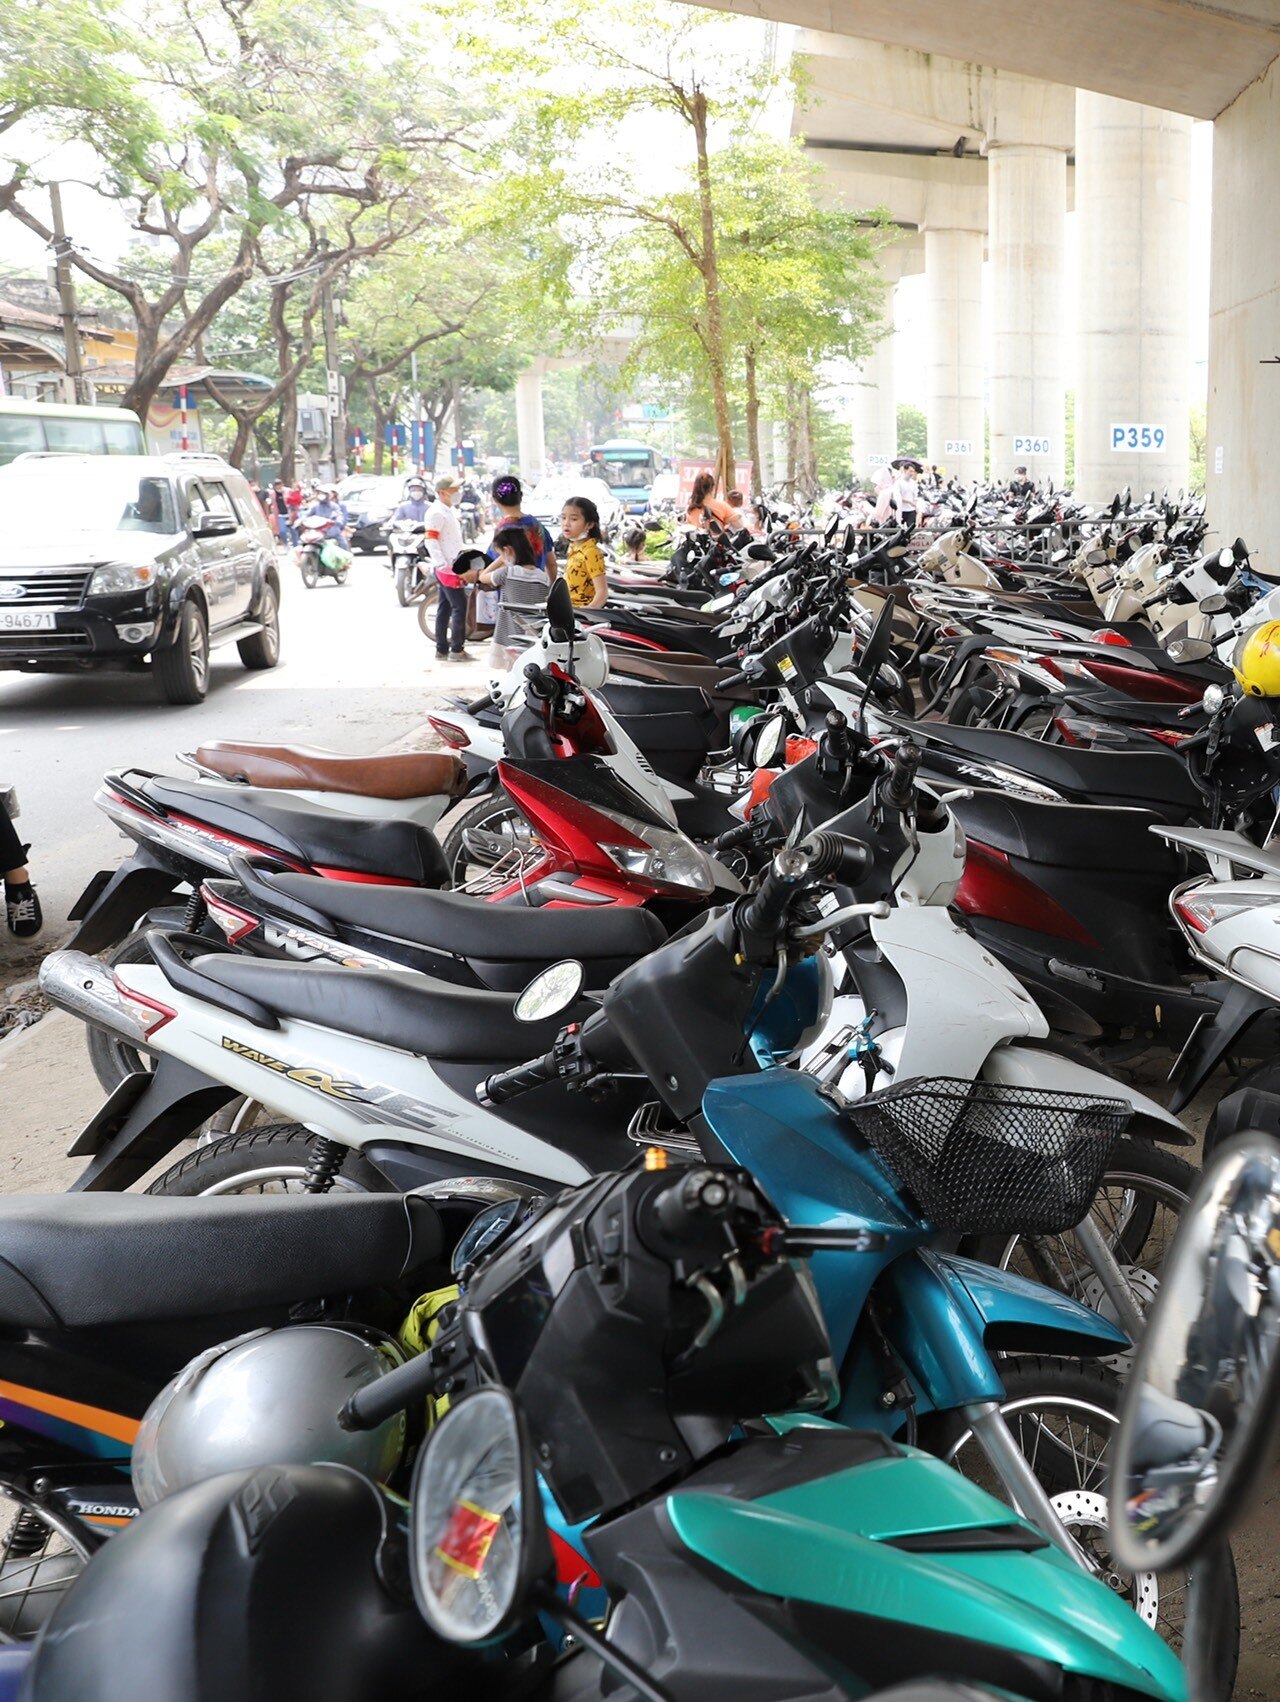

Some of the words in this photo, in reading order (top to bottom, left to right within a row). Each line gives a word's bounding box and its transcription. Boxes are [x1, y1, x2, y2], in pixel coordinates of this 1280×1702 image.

[1015, 438, 1049, 453] P360
[1112, 427, 1165, 449] P359
[946, 442, 972, 454] P361
[222, 1037, 290, 1073] WAVE
[78, 1502, 142, 1518] HONDA
